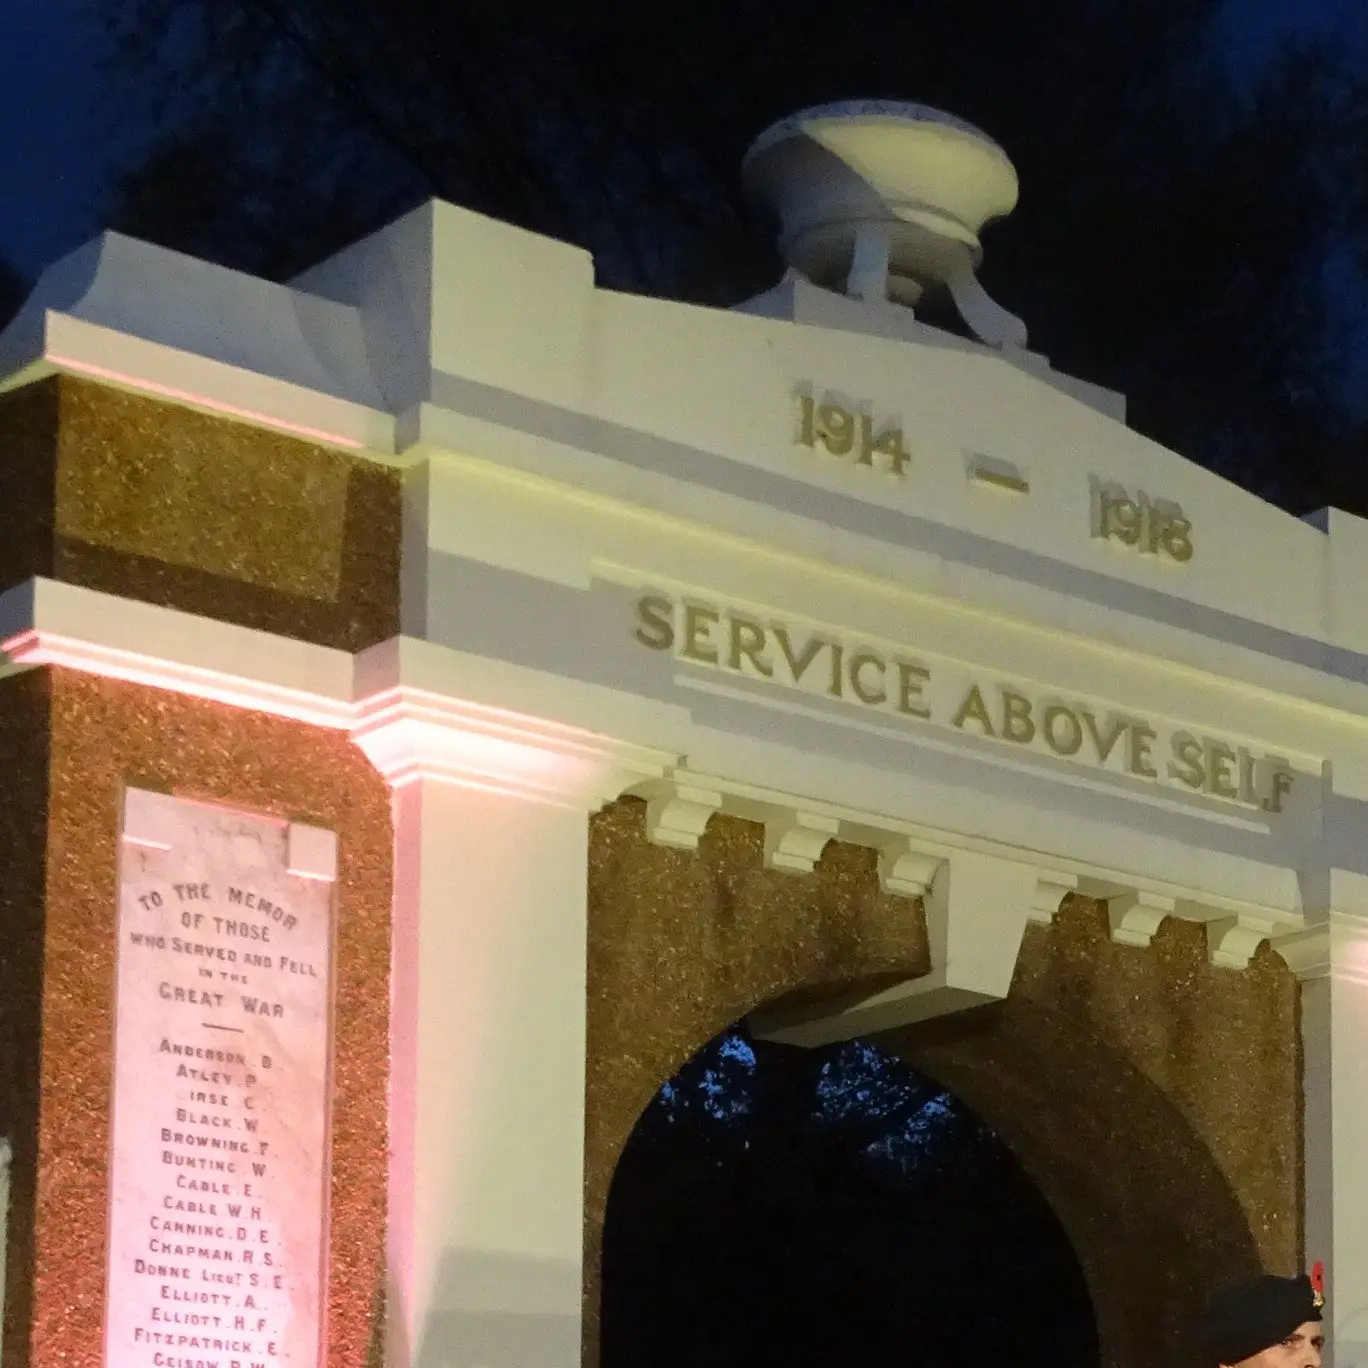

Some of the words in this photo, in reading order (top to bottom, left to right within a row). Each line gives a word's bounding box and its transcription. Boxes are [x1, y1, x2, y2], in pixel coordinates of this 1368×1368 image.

[794, 390, 911, 476] 1914
[1091, 484, 1193, 562] 1918
[635, 594, 932, 720] SERVICE
[951, 683, 1159, 779] ABOVE
[1170, 732, 1298, 814] SELF
[138, 891, 164, 912] TO
[172, 882, 212, 902] THE
[181, 911, 205, 930] OF
[212, 915, 271, 943] THOSE
[172, 936, 238, 963] SERVED
[280, 954, 318, 978] FELL
[160, 980, 225, 1008] GREAT
[242, 995, 284, 1019] WAR
